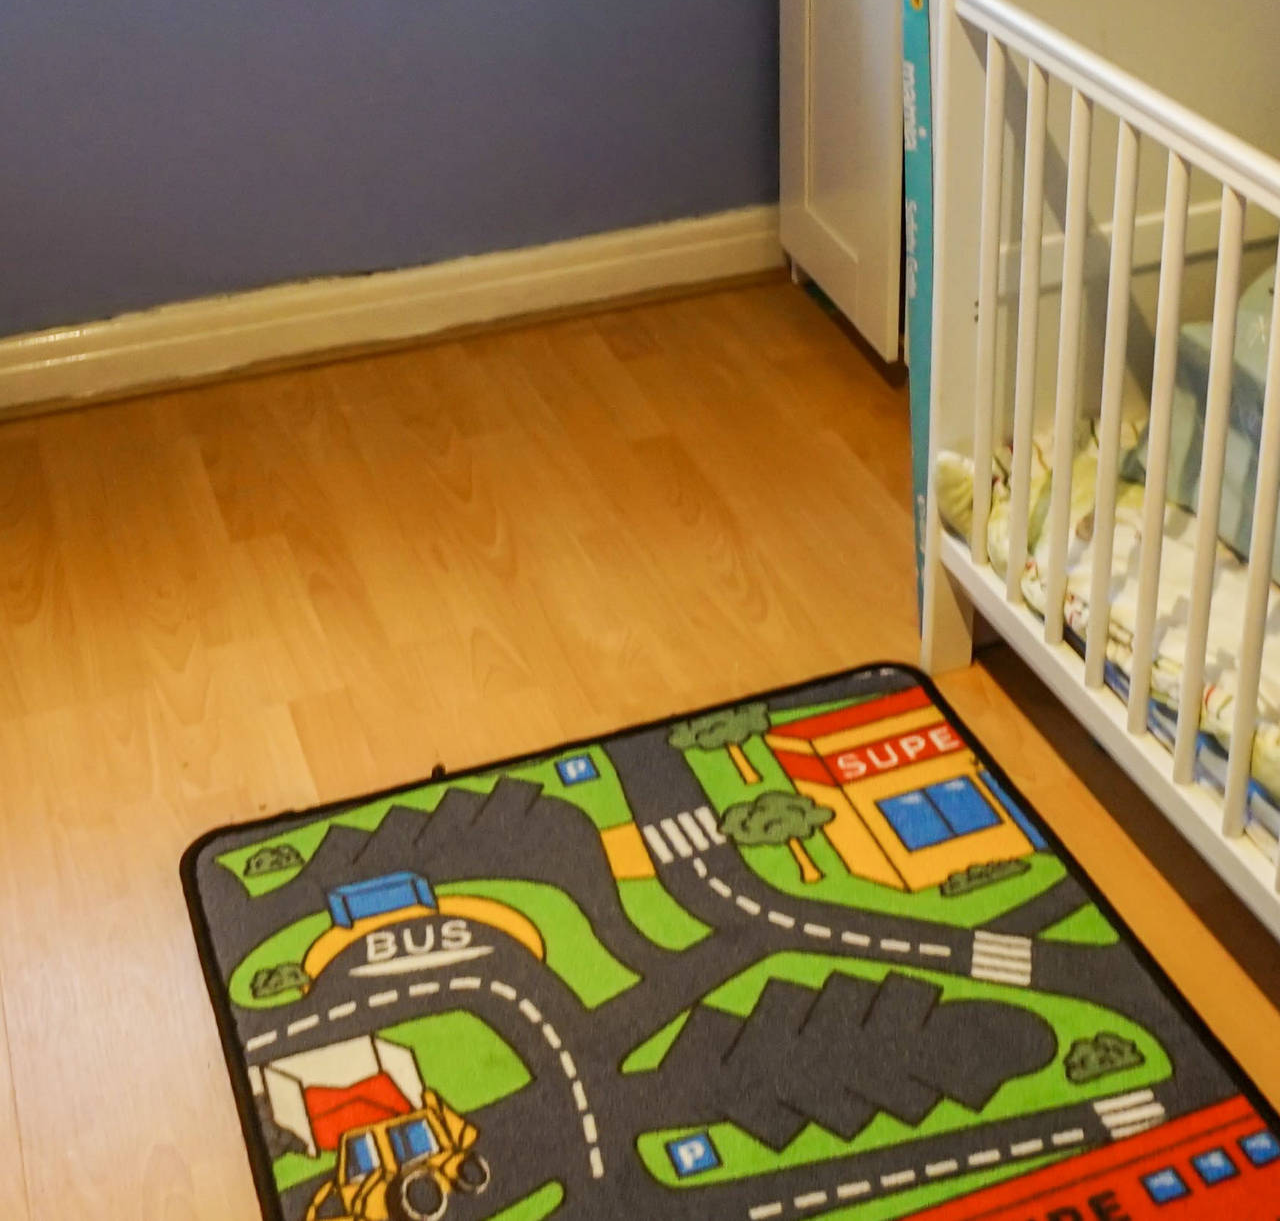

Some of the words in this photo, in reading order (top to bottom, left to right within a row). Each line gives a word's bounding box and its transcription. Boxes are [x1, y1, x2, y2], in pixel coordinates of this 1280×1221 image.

[566, 758, 586, 779] P
[837, 726, 961, 779] SUPE
[366, 919, 472, 962] BUS
[678, 1140, 705, 1171] P
